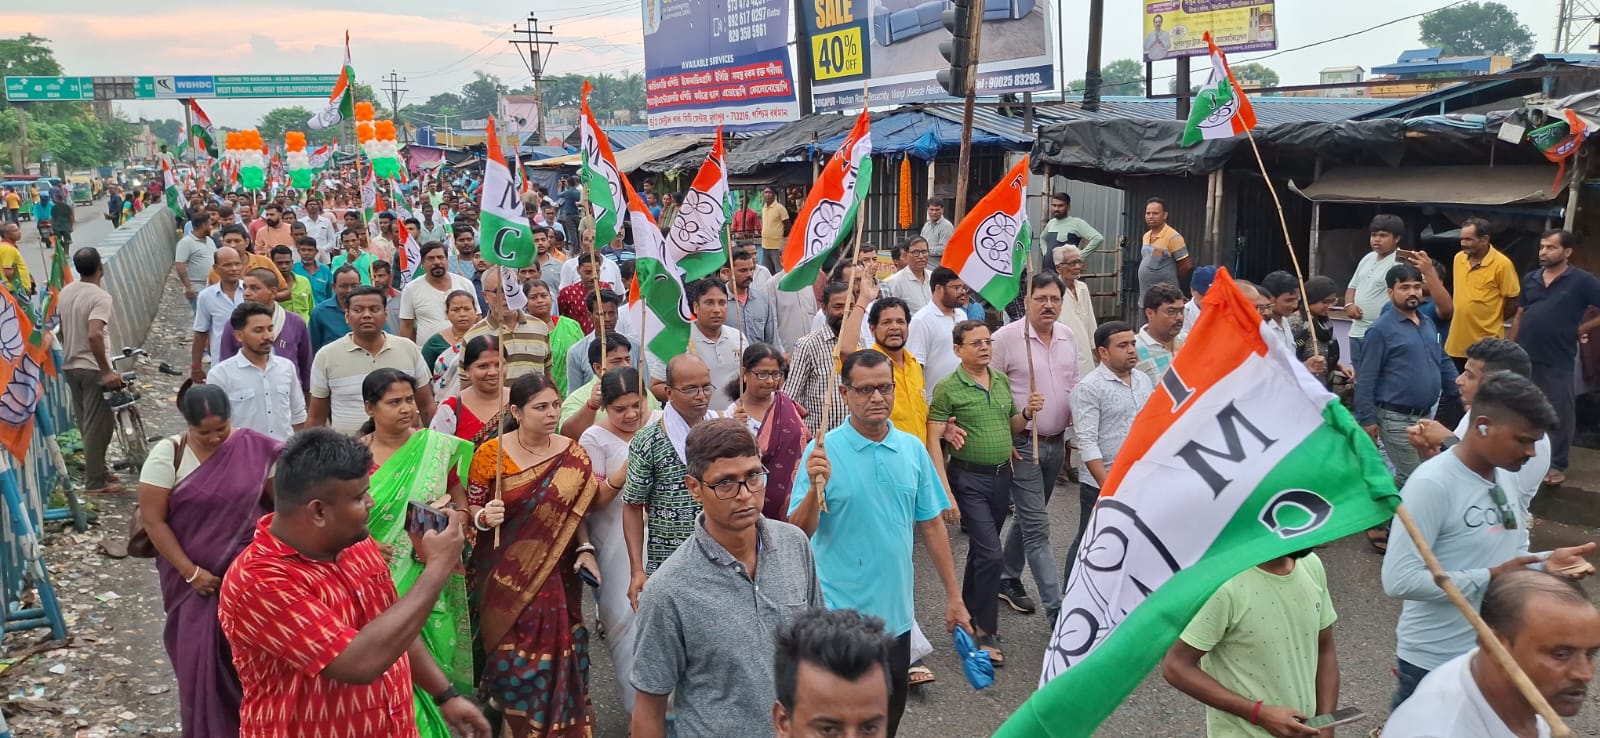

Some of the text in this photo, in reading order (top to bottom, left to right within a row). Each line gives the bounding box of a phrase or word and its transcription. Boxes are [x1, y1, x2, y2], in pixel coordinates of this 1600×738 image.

[814, 0, 854, 29] SALE
[682, 54, 735, 70] AVAILABLE SERVICES
[845, 59, 857, 71] OFF
[176, 81, 213, 89] WBHDC
